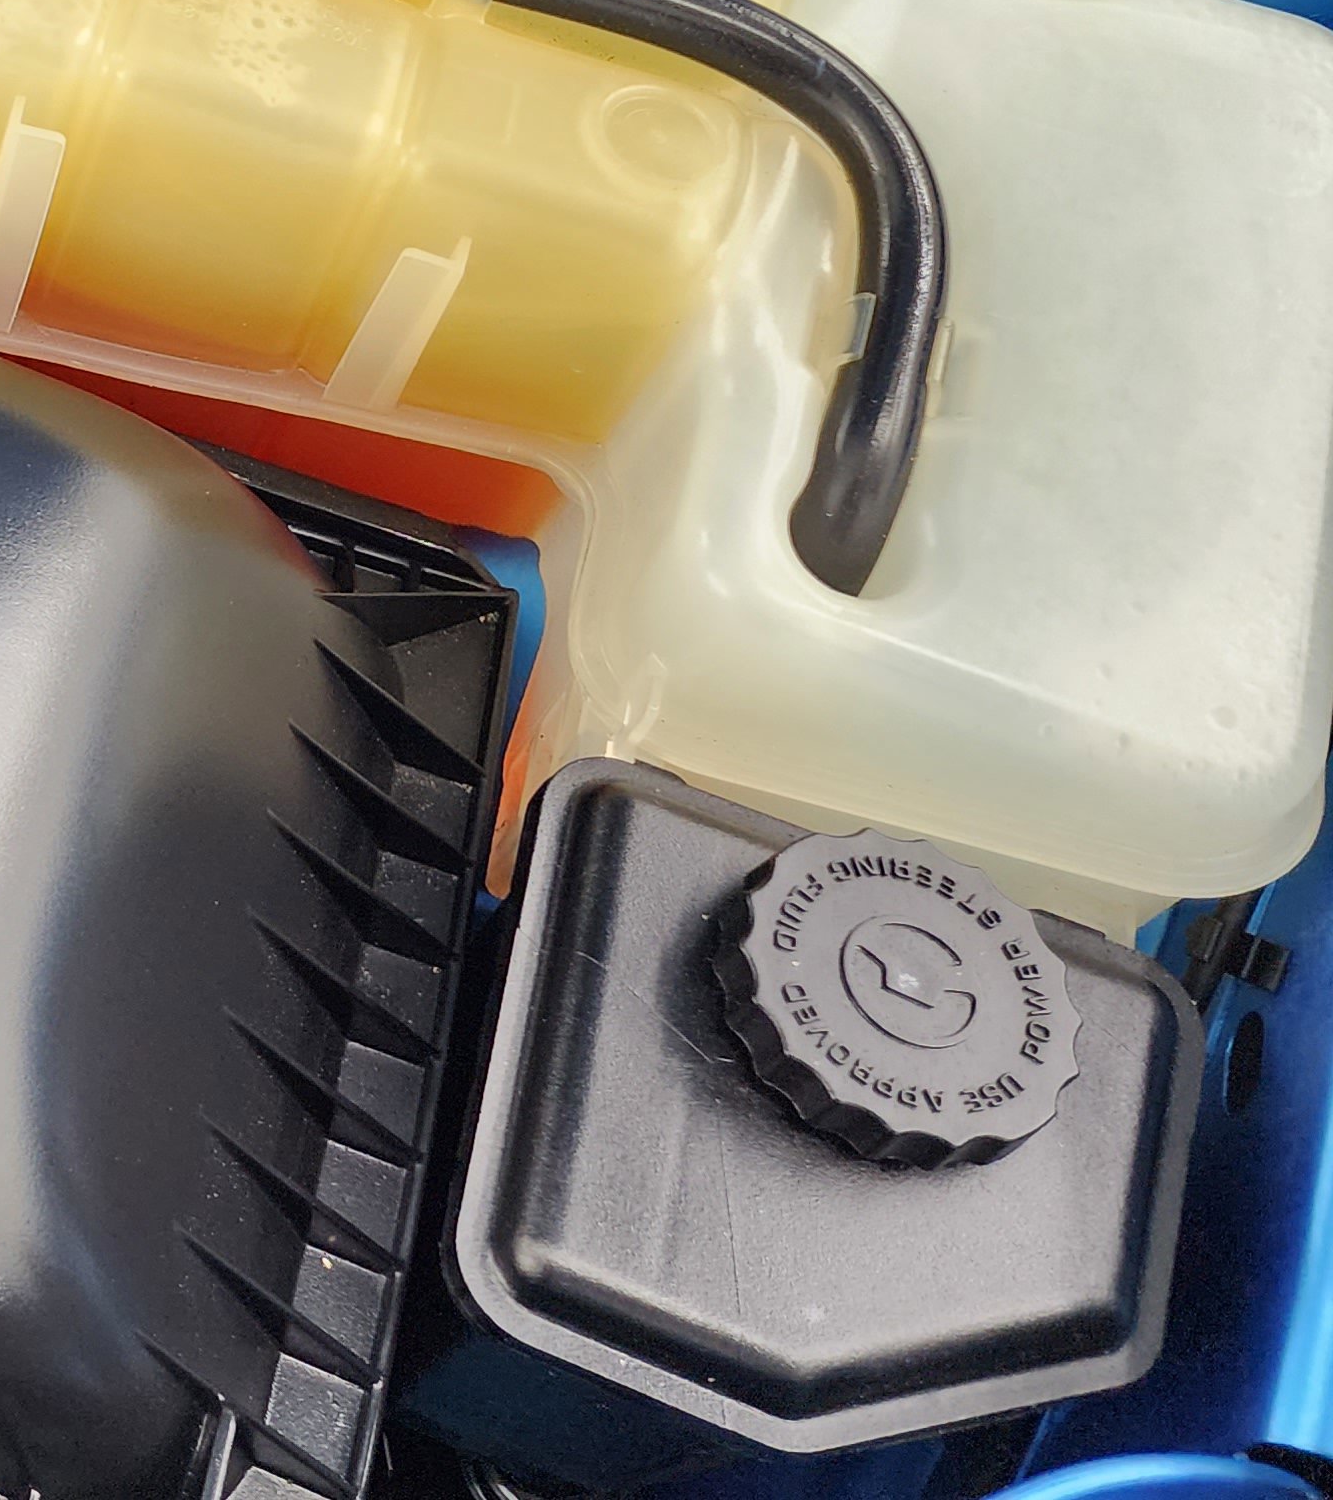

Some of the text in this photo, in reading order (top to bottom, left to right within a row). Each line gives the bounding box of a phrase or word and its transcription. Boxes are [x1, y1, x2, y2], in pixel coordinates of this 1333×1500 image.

[772, 855, 1053, 1065] POWER STEERING FLUID
[781, 981, 1026, 1114] USE APPROVED
